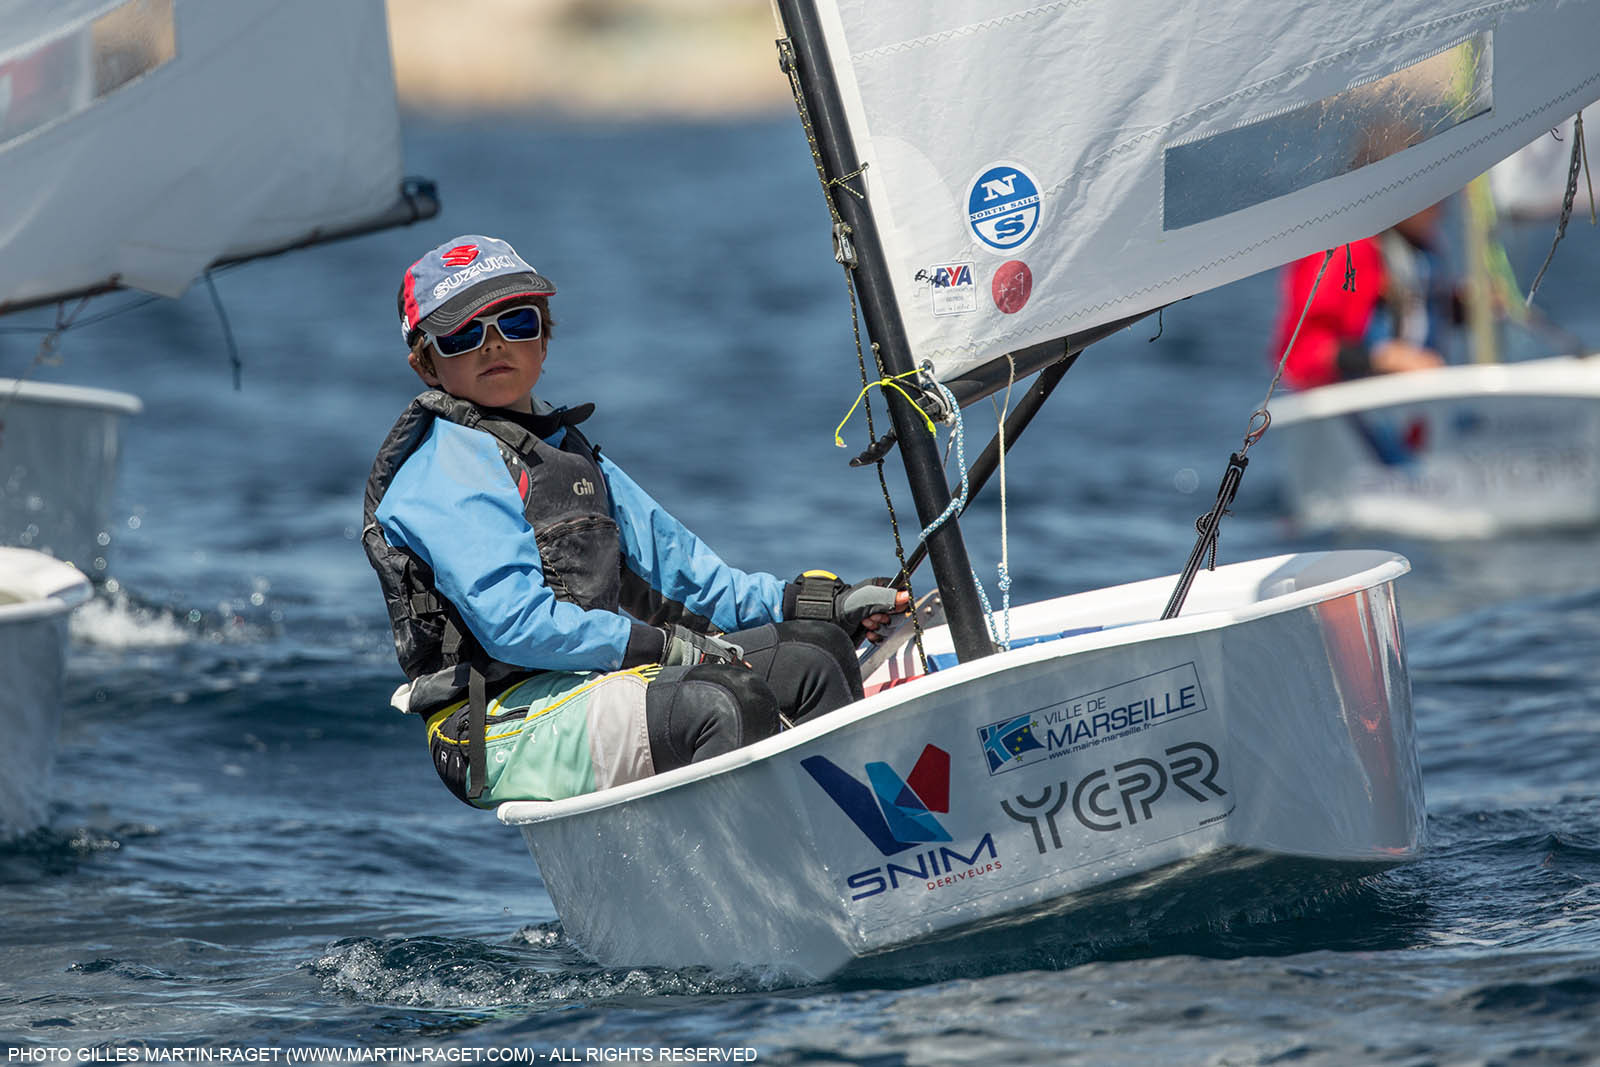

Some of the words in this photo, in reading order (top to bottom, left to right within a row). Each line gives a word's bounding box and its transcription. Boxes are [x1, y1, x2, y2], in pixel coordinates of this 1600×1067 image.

[981, 174, 1017, 202] N
[970, 206, 1006, 220] NORTH
[1010, 195, 1040, 209] SAILS
[994, 213, 1026, 240] S
[433, 255, 516, 300] SUZUKI
[935, 265, 973, 288] RYA
[573, 477, 595, 496] Gill
[1044, 704, 1082, 725] VILLE
[1086, 696, 1107, 713] DE
[1047, 685, 1197, 750] MARSEILLE
[1049, 722, 1153, 760] www.mairie-marseille.fr
[1000, 741, 1228, 854] YCPR
[847, 832, 999, 901] SNIM
[927, 861, 1003, 891] DERIVEURS
